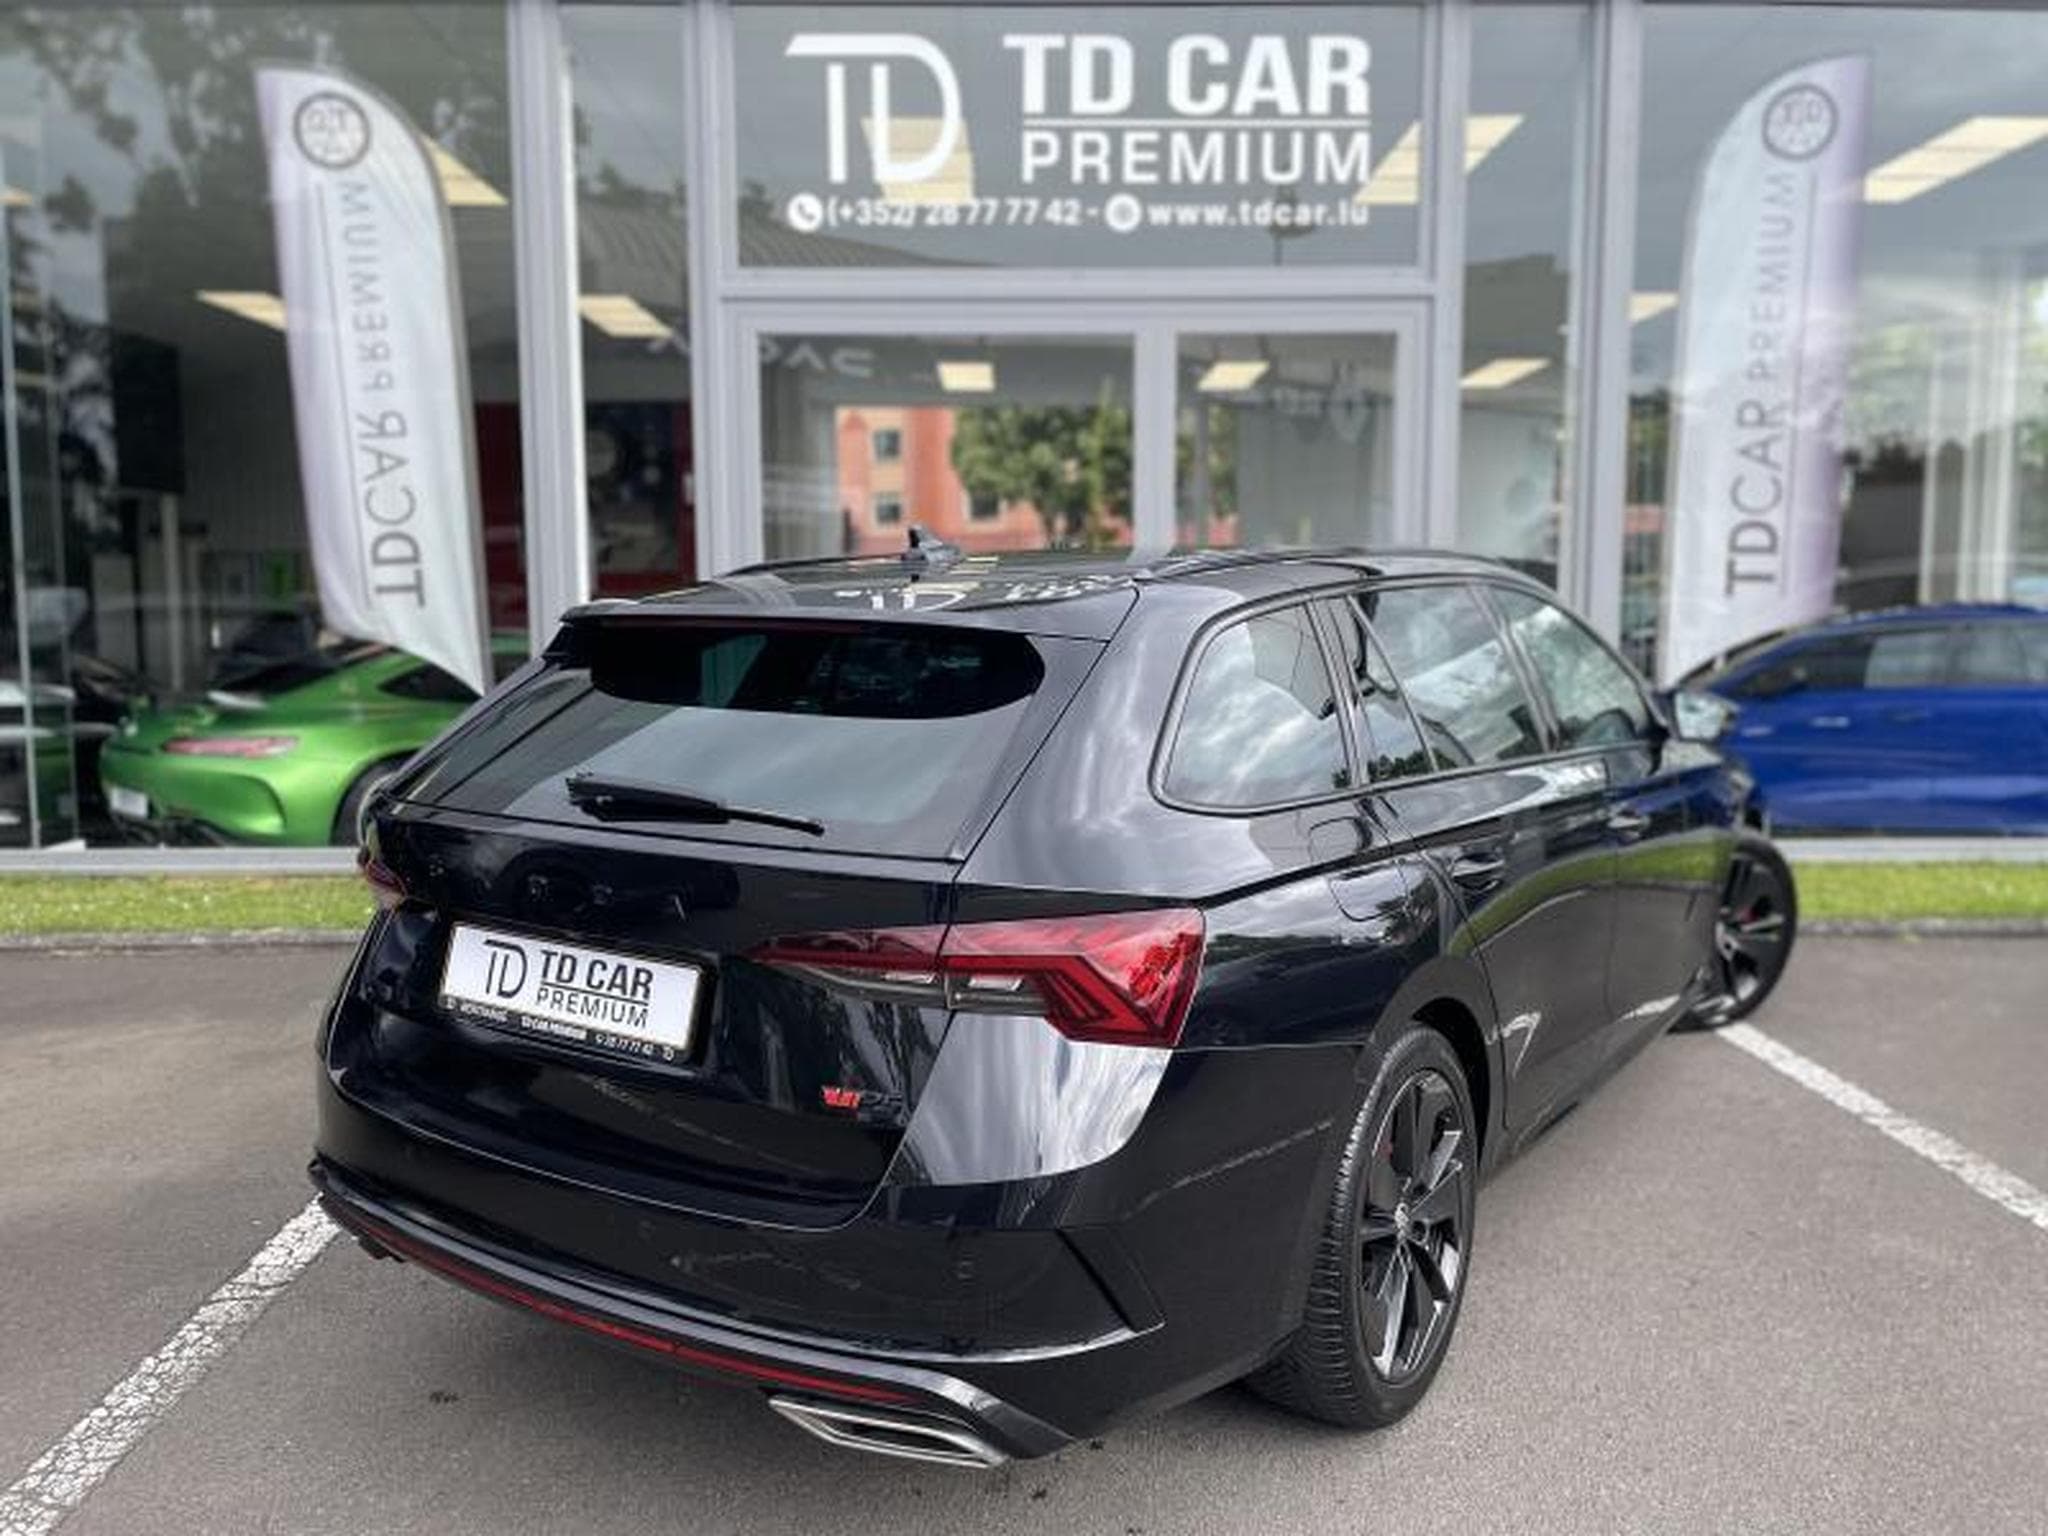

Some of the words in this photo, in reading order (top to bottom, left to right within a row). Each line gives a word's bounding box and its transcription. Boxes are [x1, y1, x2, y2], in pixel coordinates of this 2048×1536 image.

[1003, 34, 1134, 115] TD
[1167, 33, 1371, 115] CAR
[1022, 131, 1371, 184] PREMIUM
[964, 197, 999, 227] 77
[1004, 197, 1039, 227] 77
[1044, 197, 1081, 227] 42
[1148, 197, 1371, 227] www.tdcar.lu
[1748, 172, 1797, 384] PREMIUM
[540, 950, 577, 984] TD
[586, 959, 654, 1000] CAR
[536, 987, 649, 1029] PREMIUM
